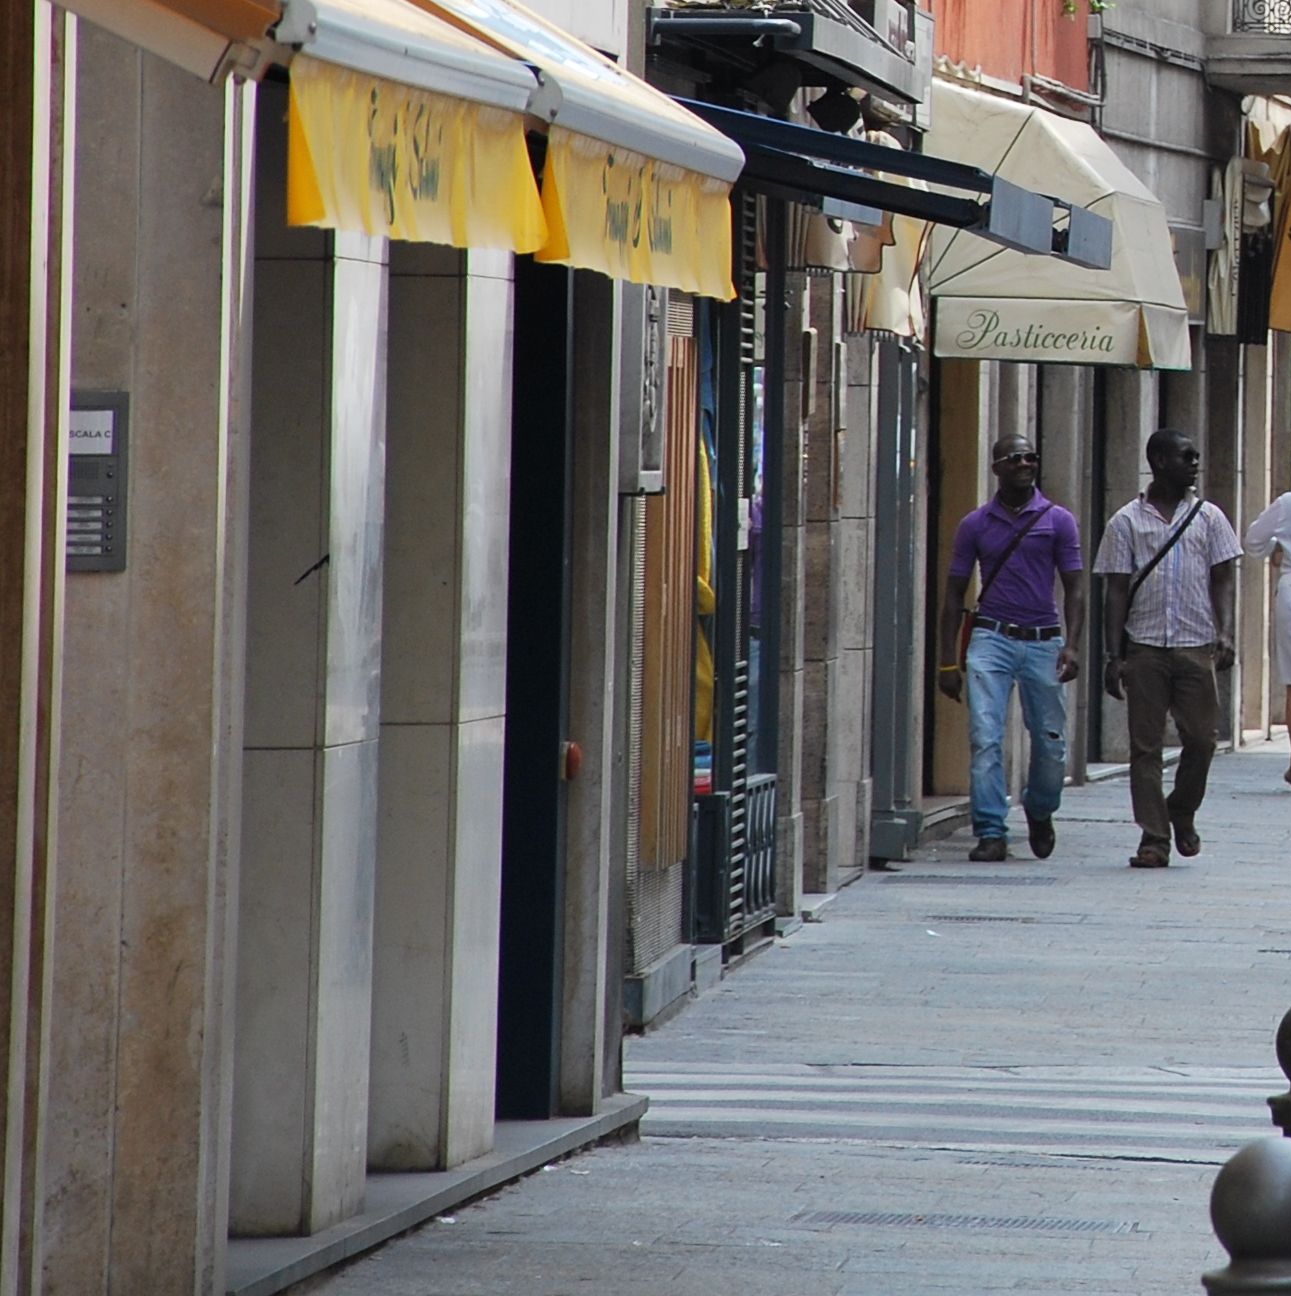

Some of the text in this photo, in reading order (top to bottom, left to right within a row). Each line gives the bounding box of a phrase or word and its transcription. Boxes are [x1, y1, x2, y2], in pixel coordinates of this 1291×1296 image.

[955, 308, 1115, 353] Pasticceria
[69, 429, 111, 439] SCALA C
